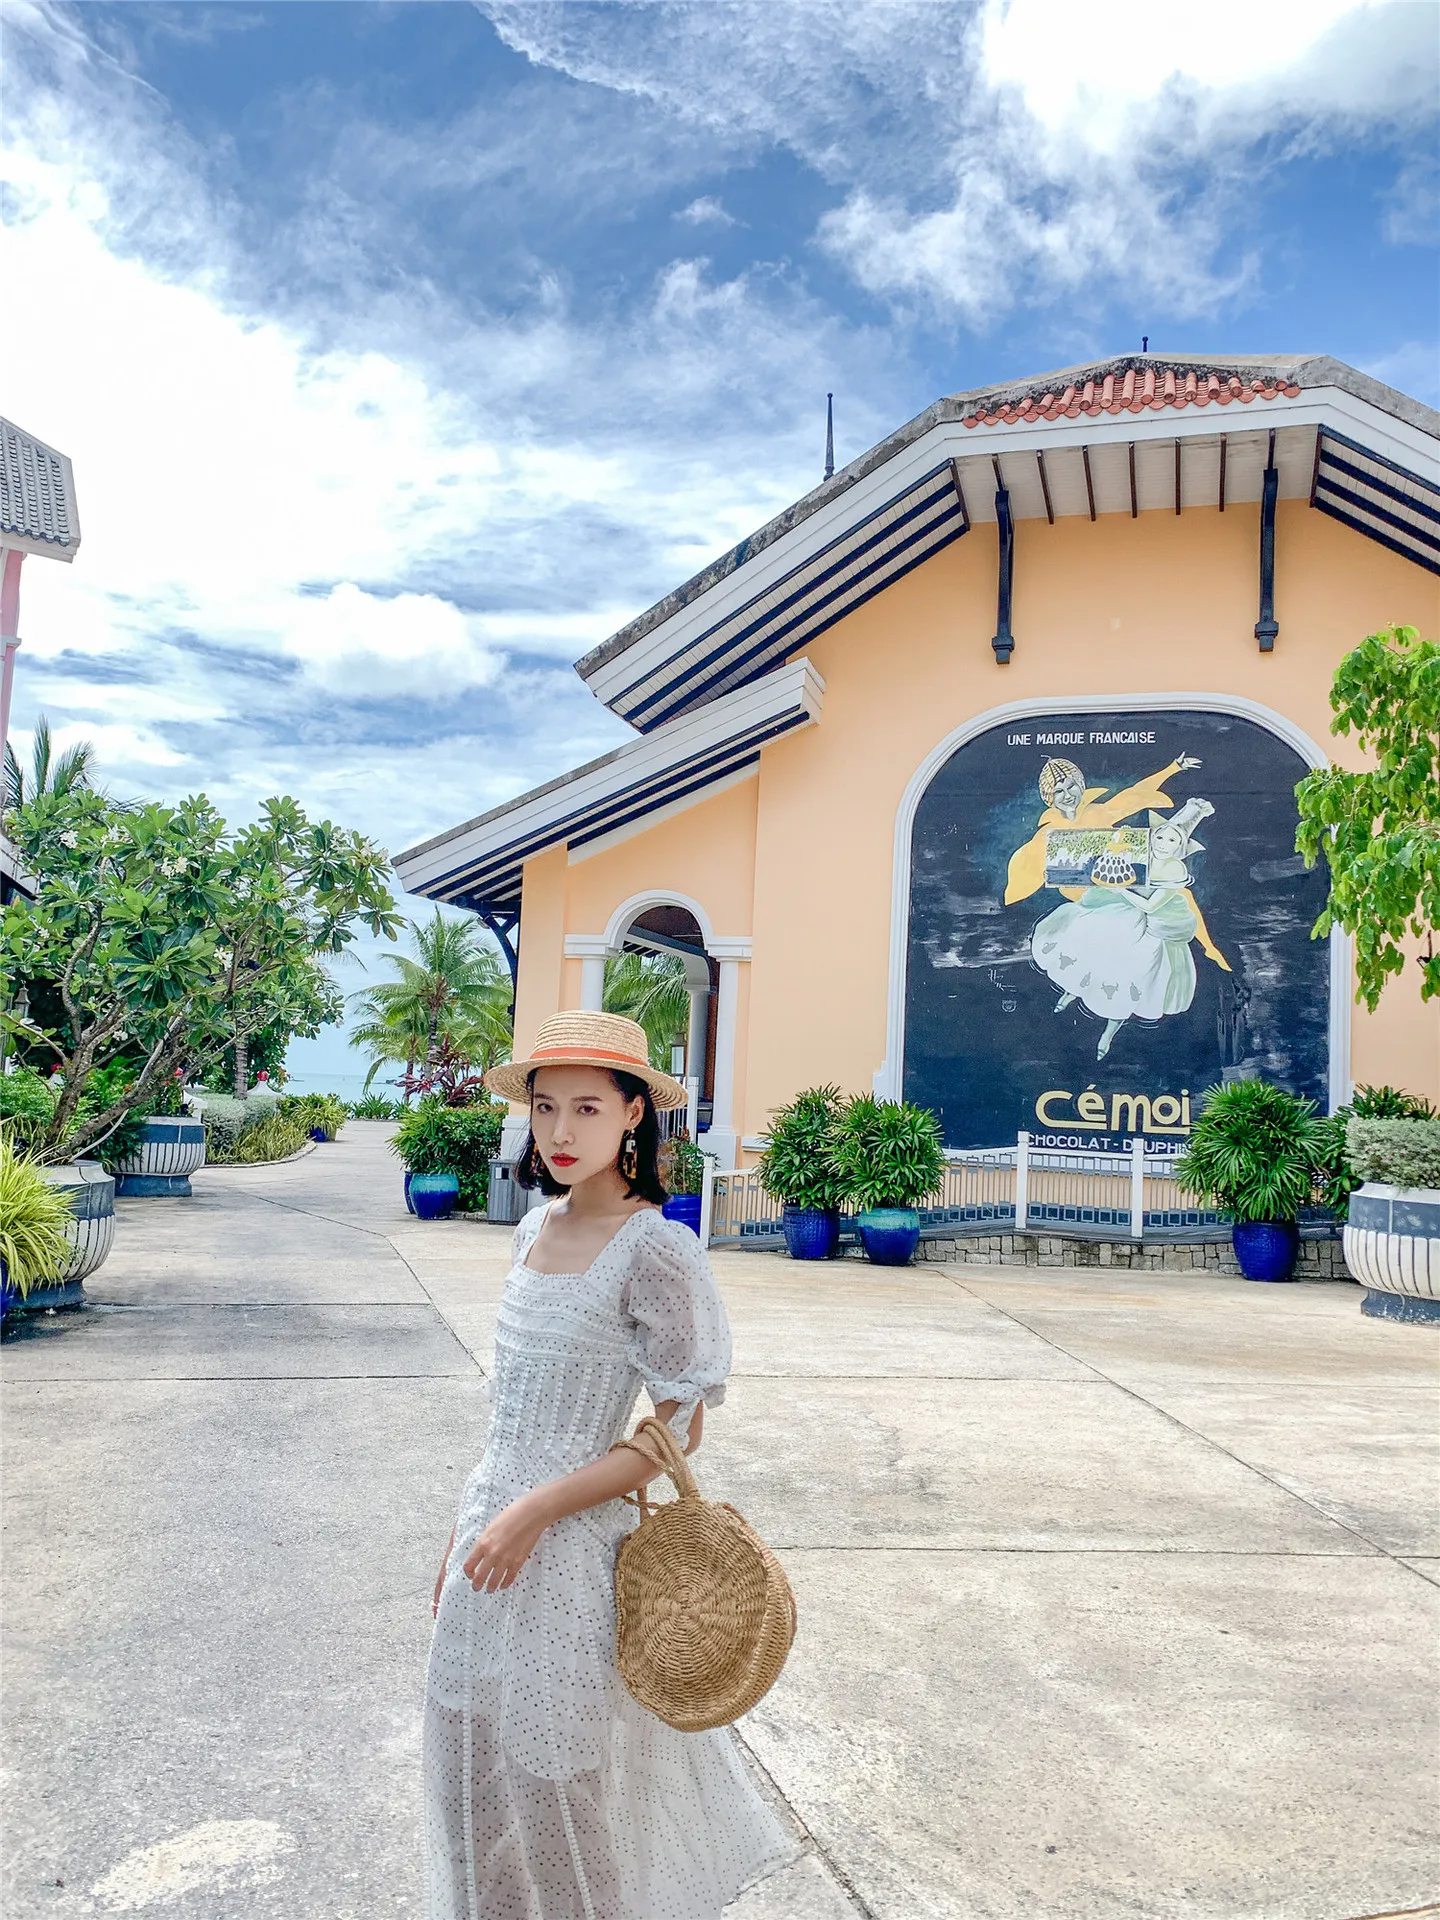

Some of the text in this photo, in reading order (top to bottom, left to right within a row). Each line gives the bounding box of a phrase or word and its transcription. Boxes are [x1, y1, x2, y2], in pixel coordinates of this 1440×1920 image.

[1007, 731, 1156, 746] UNE MARQUE FRANCAISE
[1028, 1134, 1111, 1149] CHOCOLAT
[1122, 1139, 1193, 1155] DUPHIN
